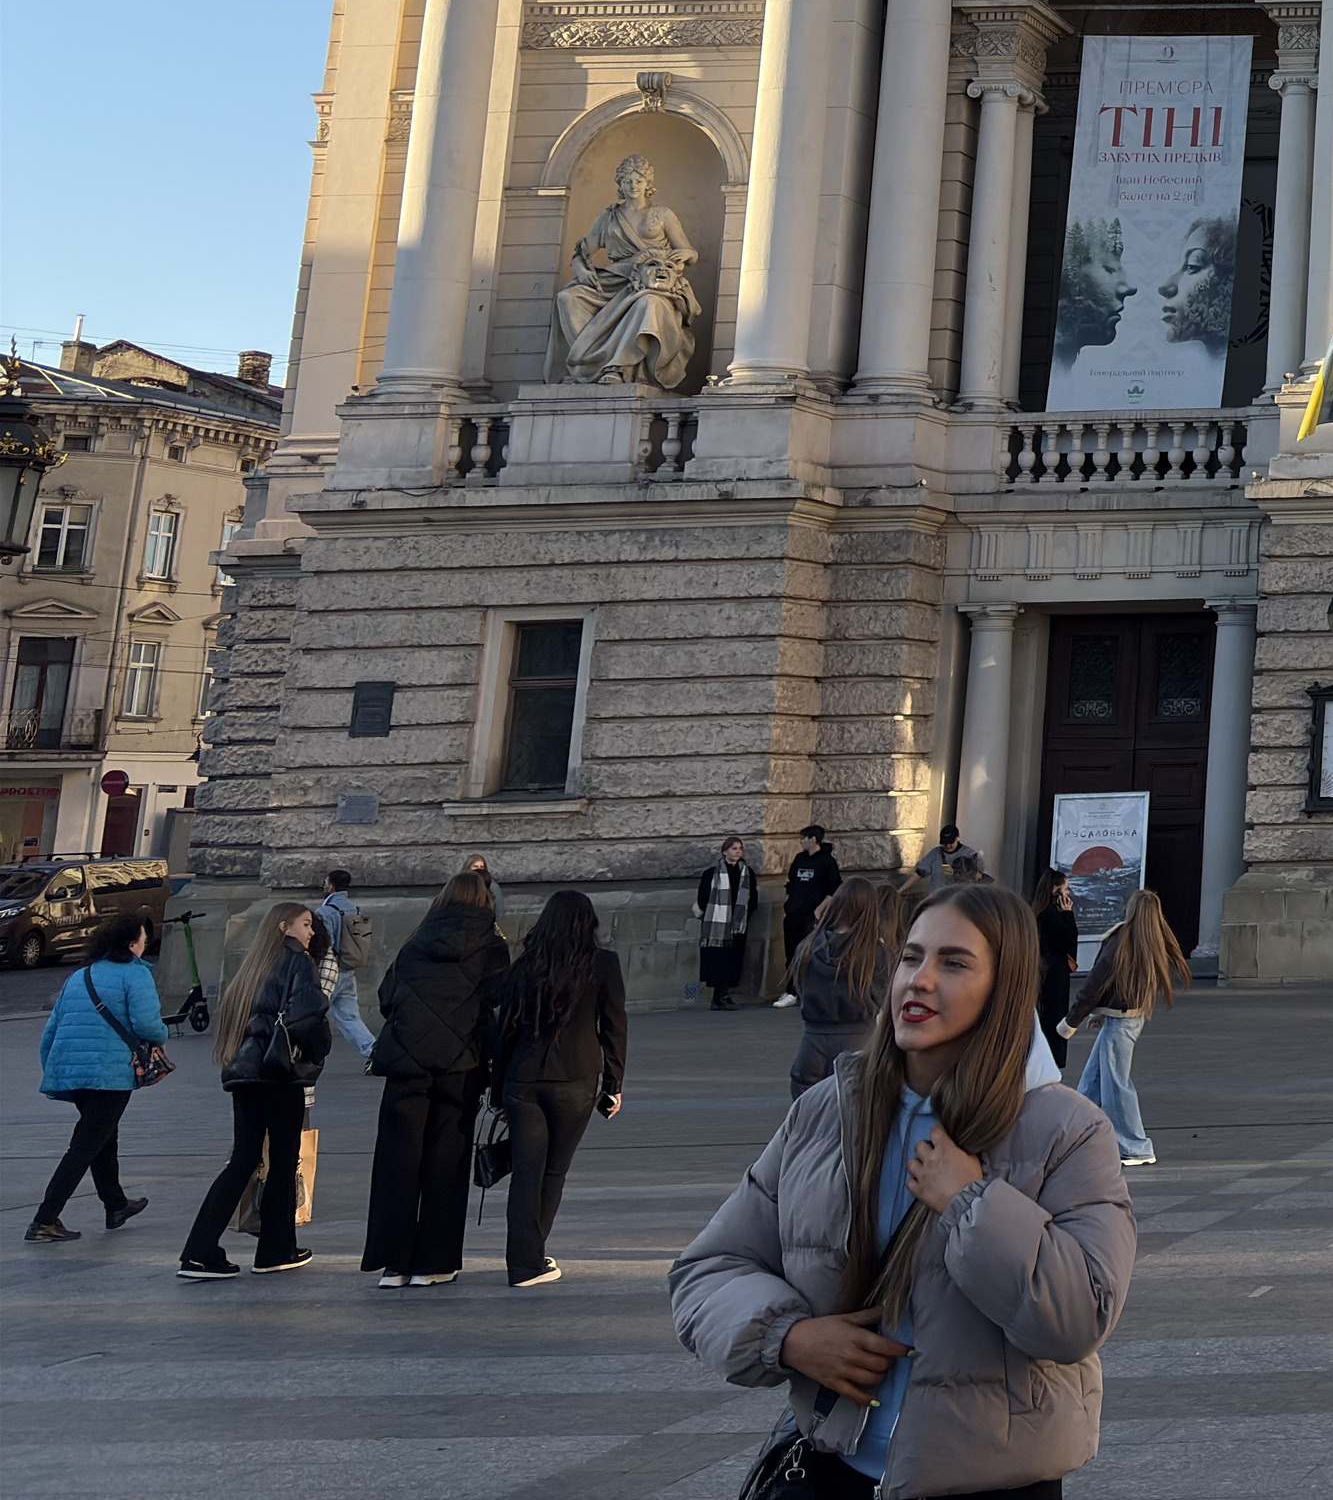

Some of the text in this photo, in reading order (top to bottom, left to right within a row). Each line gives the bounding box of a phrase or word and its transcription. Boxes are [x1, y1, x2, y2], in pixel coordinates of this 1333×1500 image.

[1119, 81, 1214, 95] ПРЕМ'ЄРА
[1098, 103, 1224, 147] ТІНІ
[1098, 152, 1221, 164] ЗАБУТИХ ПРЕДКІВ
[1116, 175, 1203, 184] Іван Небесний
[1119, 191, 1152, 200] балет
[1064, 829, 1137, 838] РУСАЛОНЬКА
